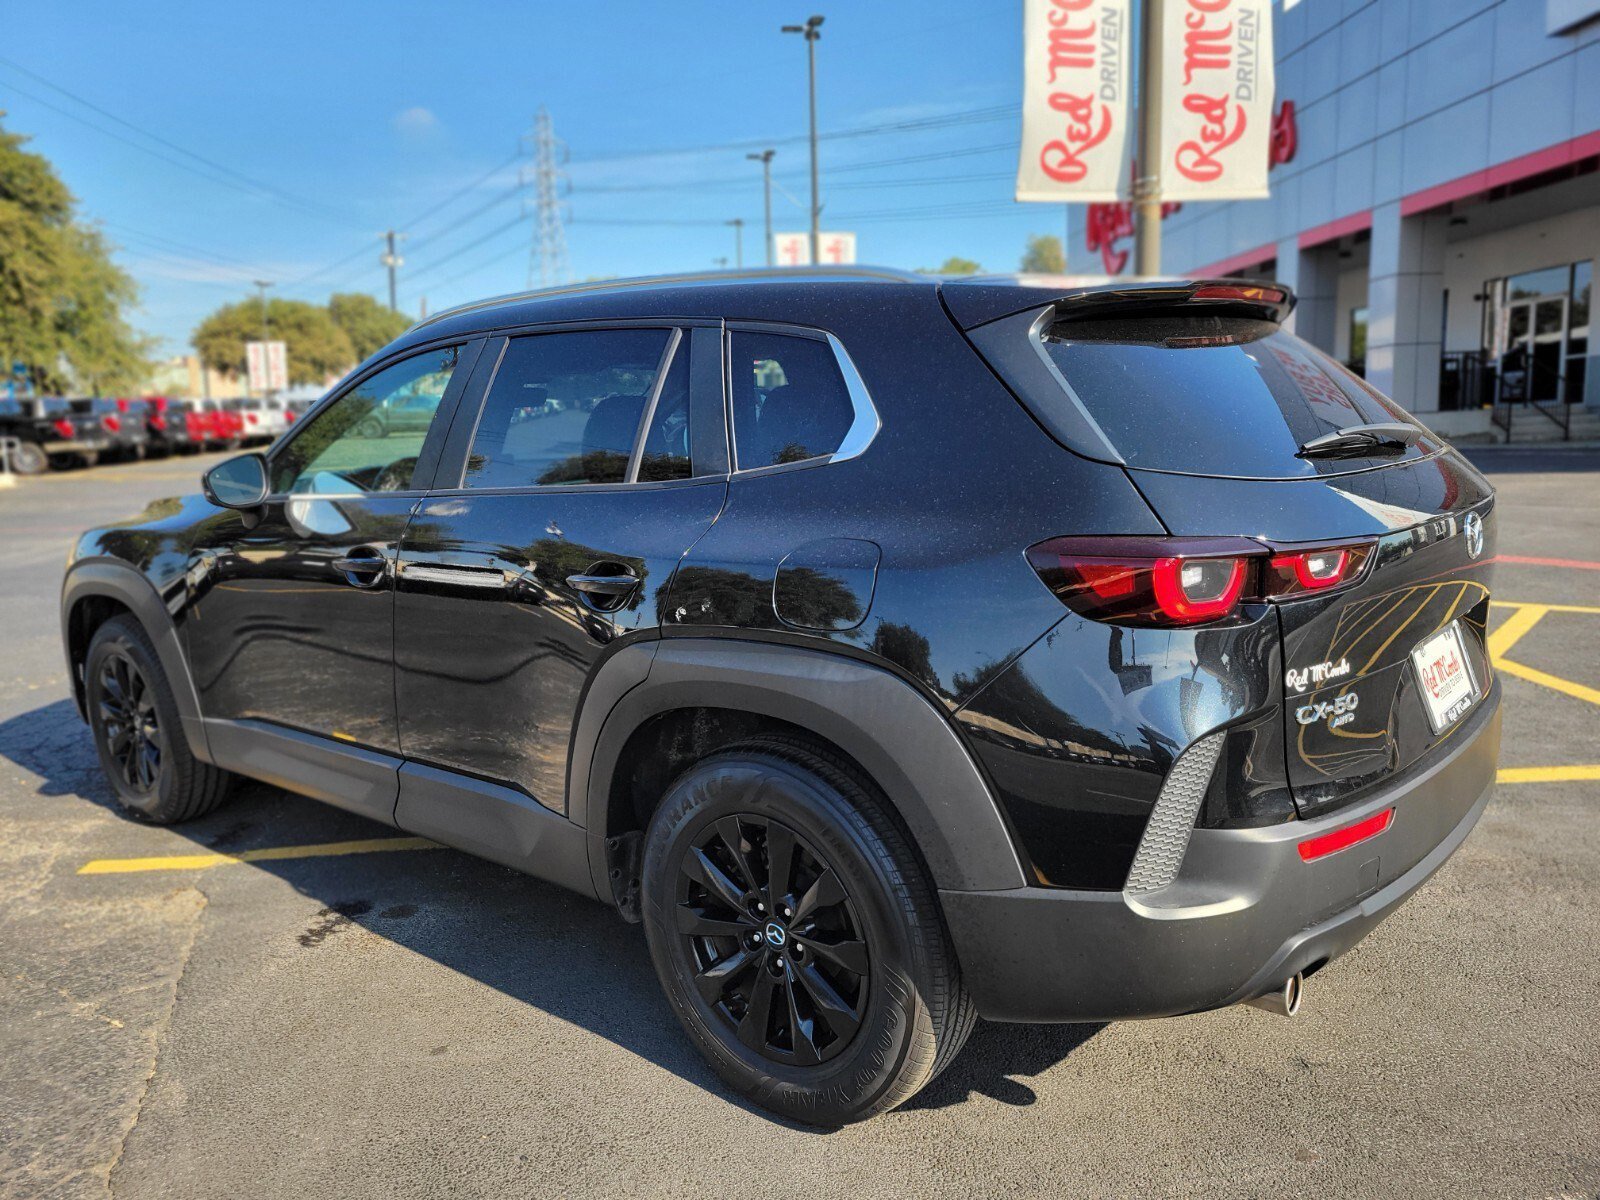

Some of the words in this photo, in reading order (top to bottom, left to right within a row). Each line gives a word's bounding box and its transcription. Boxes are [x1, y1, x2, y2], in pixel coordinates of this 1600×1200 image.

[1100, 7, 1119, 102] DRIVEN
[1236, 8, 1255, 102] DRIVEN
[1040, 92, 1112, 184] Red
[1174, 93, 1247, 183] Red
[1286, 668, 1309, 692] Red
[1295, 692, 1359, 725] CX-50
